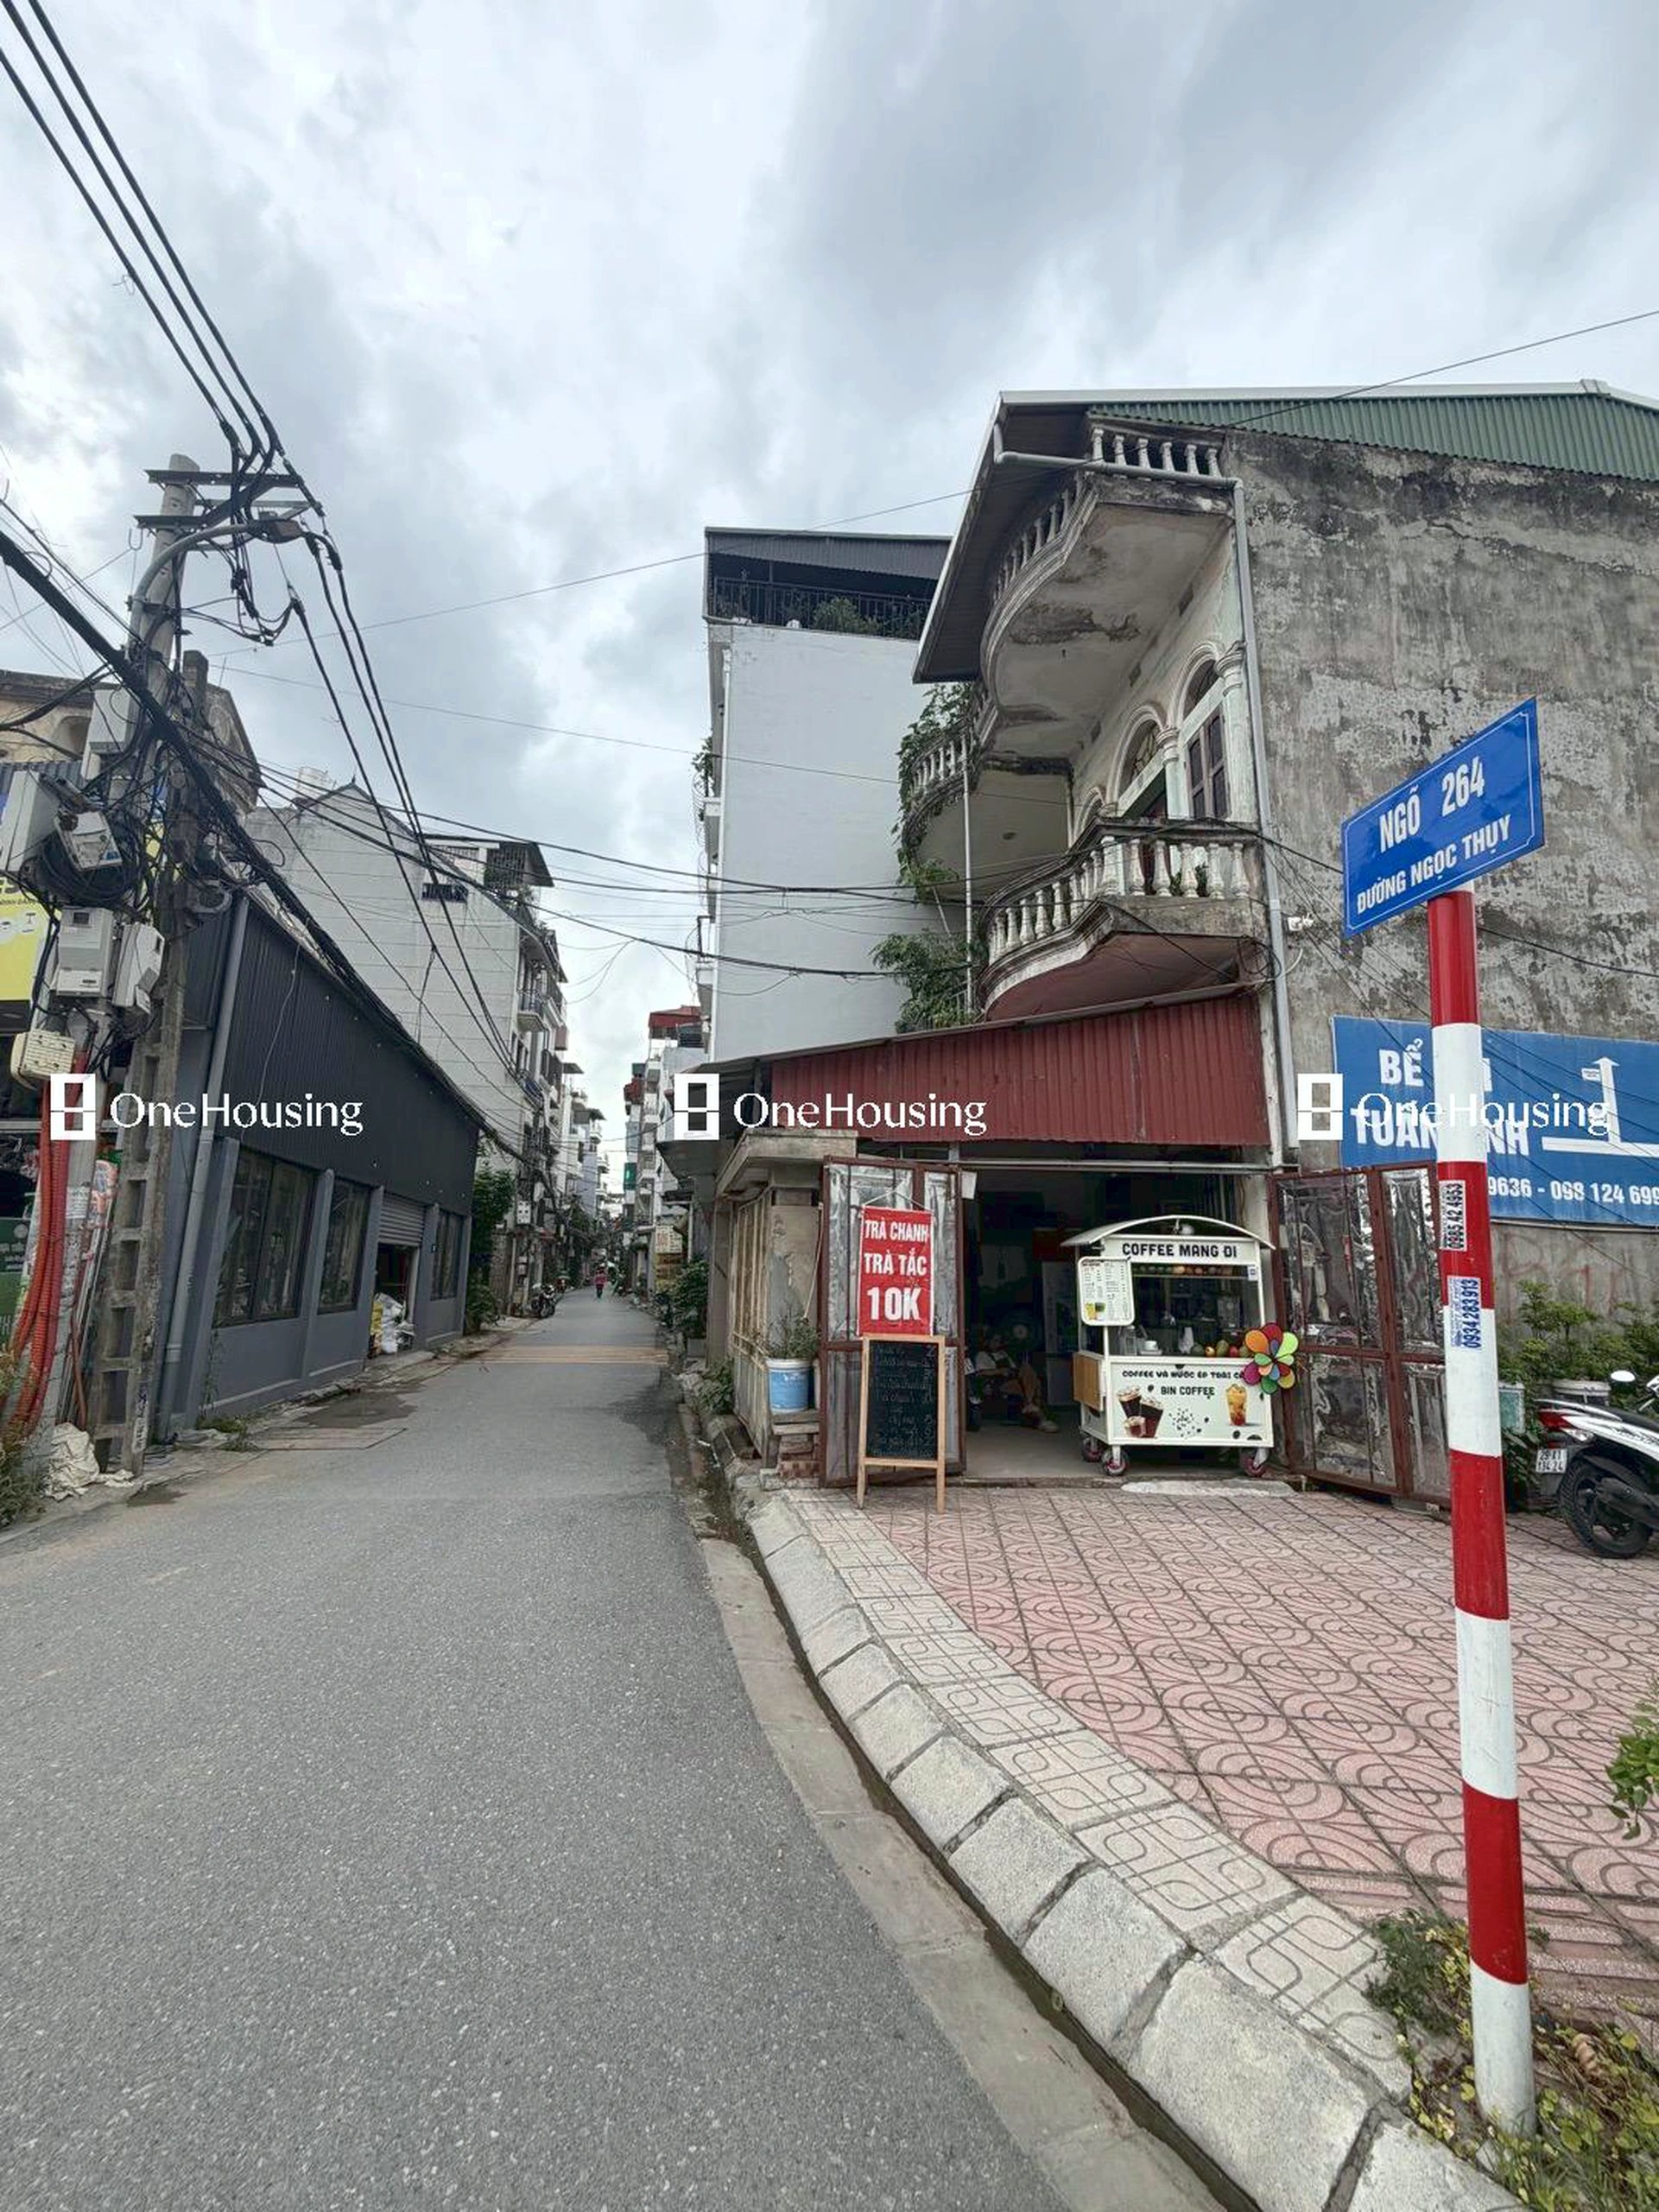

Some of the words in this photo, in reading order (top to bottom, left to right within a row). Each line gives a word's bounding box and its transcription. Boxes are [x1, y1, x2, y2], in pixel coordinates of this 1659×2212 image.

[1379, 784, 1421, 853] NGÕ
[1441, 756, 1485, 817] 264
[1411, 844, 1457, 887] NGỌC
[1462, 814, 1511, 859] THỤY
[1550, 1181, 1585, 1201] 098
[1590, 1182, 1624, 1204] 124
[864, 1217, 887, 1239] TRÀ
[890, 1221, 928, 1242] CHANH
[864, 1249, 895, 1275] TRÀ
[898, 1247, 927, 1276] TẮC
[1123, 1243, 1174, 1256] COFFEE
[1179, 1245, 1219, 1258] MANG
[1223, 1245, 1238, 1258] ĐI
[867, 1287, 921, 1321] 10K
[1161, 1386, 1176, 1395] BIN
[1179, 1386, 1215, 1396] COFFEE
